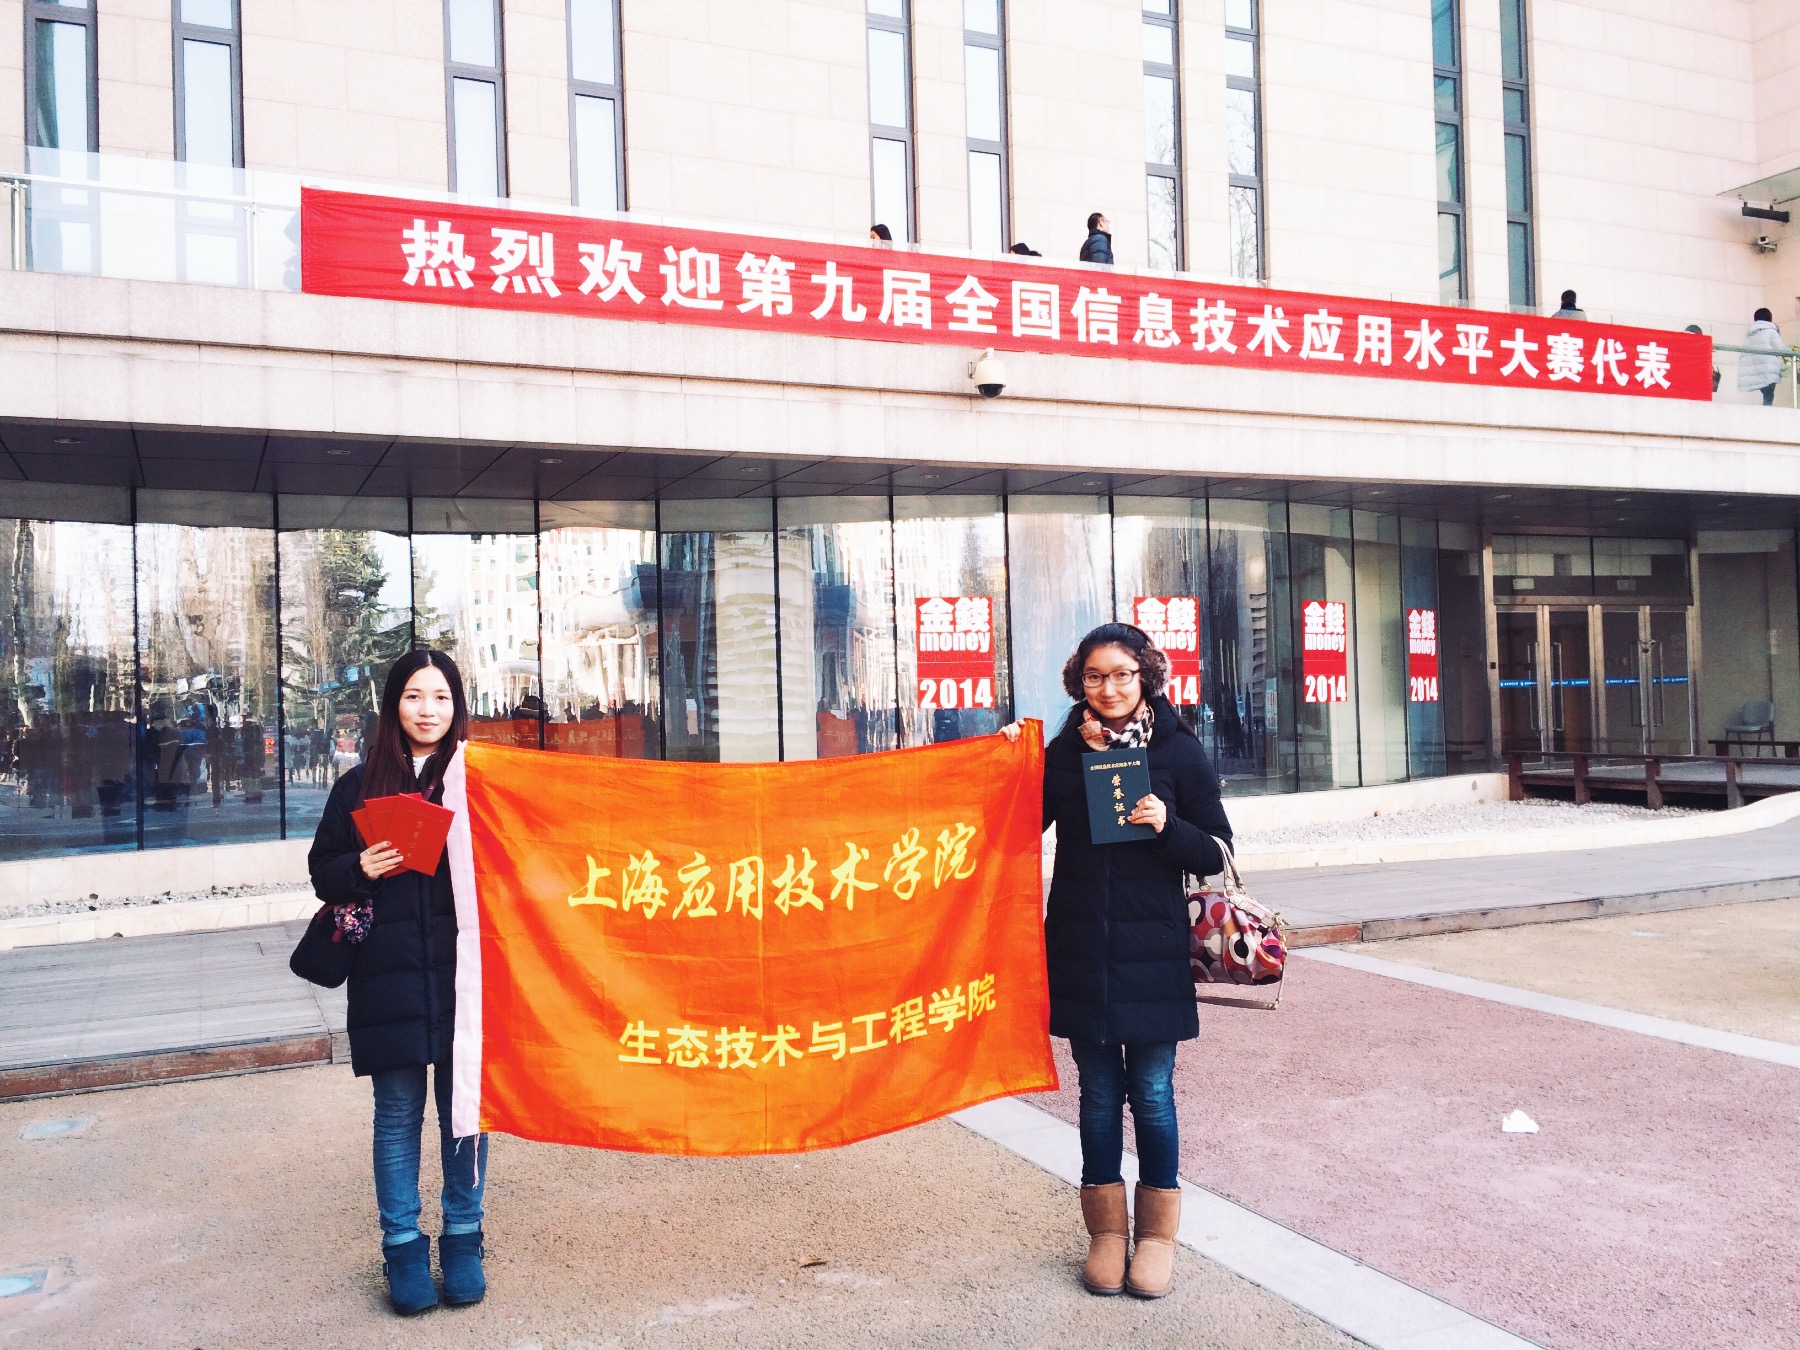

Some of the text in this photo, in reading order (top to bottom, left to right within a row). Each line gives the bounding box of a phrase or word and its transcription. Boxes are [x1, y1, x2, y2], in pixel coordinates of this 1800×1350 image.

[400, 218, 1671, 389] 热烈欢迎第九届全国信息技术应用水平大赛代表
[918, 597, 990, 632] 金錢
[1136, 597, 1197, 632] 金錢
[1304, 601, 1345, 635] 金錢
[919, 632, 991, 653] money
[1147, 631, 1197, 652] oney
[1304, 634, 1346, 653] money
[1409, 638, 1436, 656] money
[919, 678, 993, 709] 2014
[1162, 676, 1199, 705] 14
[1305, 675, 1347, 703] 2014
[1410, 676, 1438, 702] 2014
[567, 822, 977, 921] 上海应用技术学院
[618, 972, 997, 1070] 生态技术与工程学院
